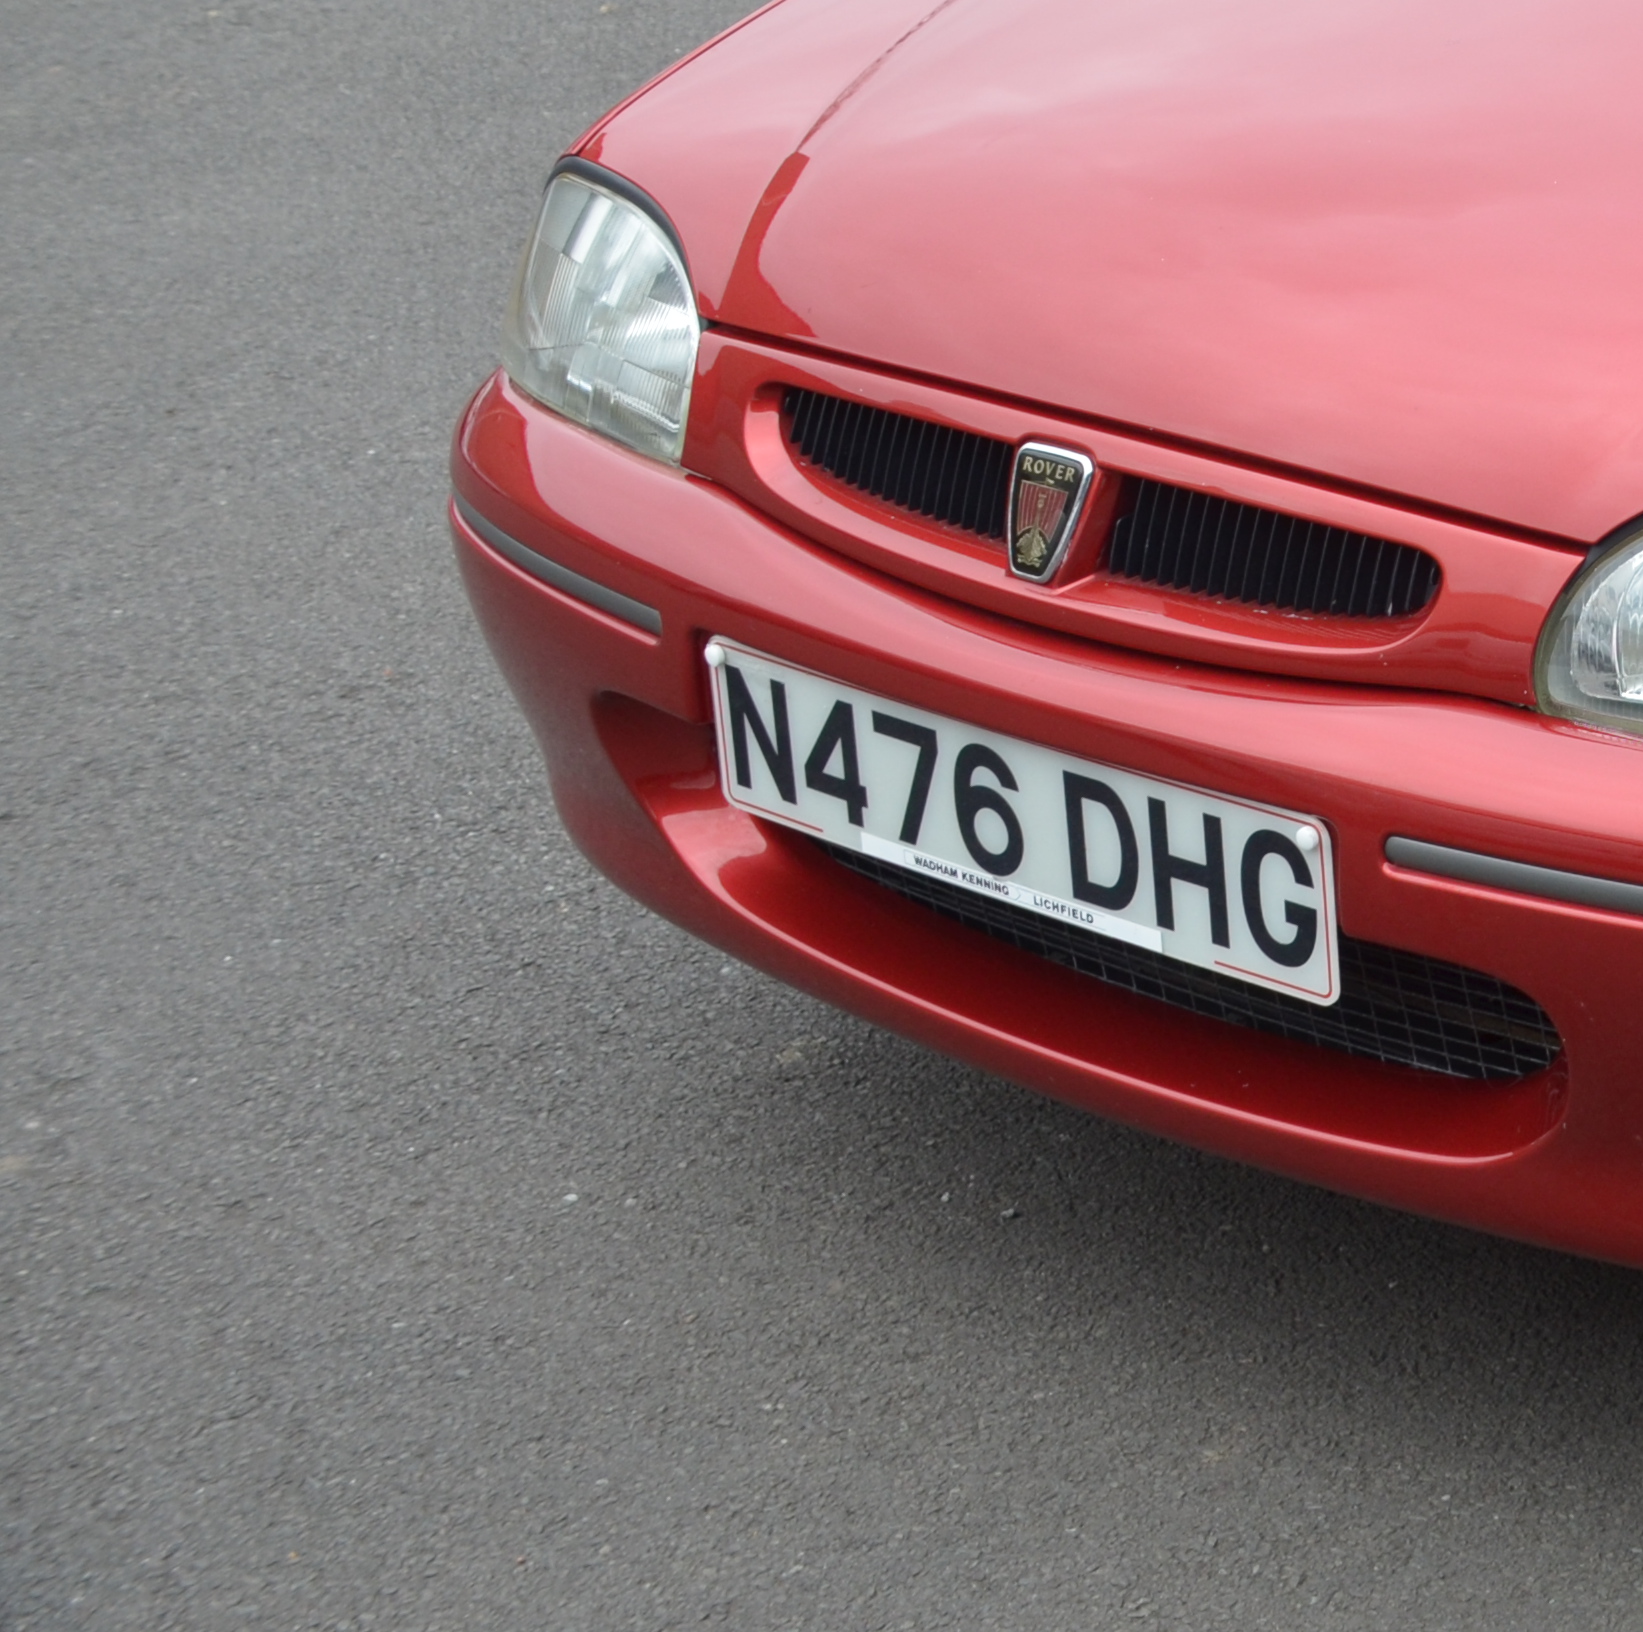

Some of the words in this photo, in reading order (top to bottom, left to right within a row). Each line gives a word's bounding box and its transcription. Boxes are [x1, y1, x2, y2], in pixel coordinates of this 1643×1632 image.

[1022, 455, 1076, 483] ROVER
[724, 664, 1025, 878] N476
[1061, 770, 1320, 969] DHG
[913, 854, 959, 879] WADHAM
[961, 871, 1010, 897] KENNING
[1033, 894, 1095, 925] LICHFIELD
